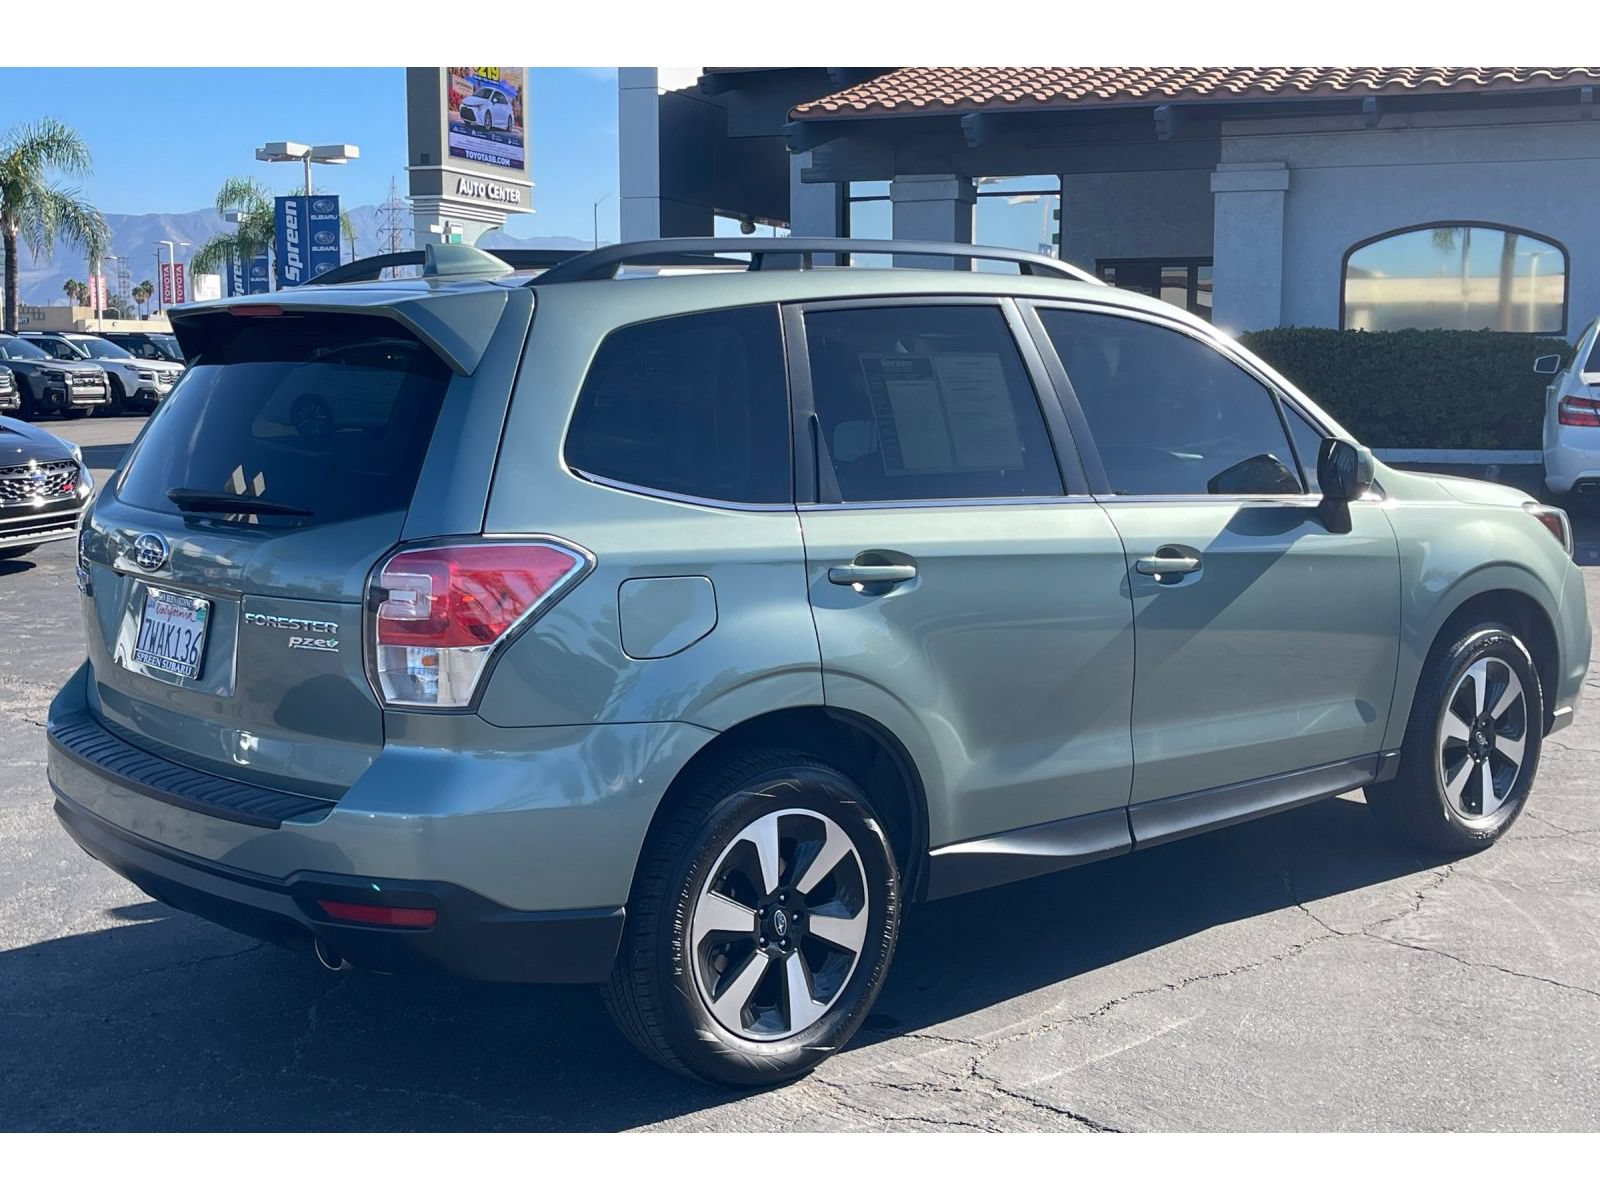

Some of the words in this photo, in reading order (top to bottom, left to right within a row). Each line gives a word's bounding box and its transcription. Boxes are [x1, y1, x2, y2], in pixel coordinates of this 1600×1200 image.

[459, 178, 486, 197] AUTO
[487, 183, 520, 203] CENTER
[284, 200, 303, 282] Spreen
[163, 266, 171, 302] TOYOTA
[175, 265, 183, 302] TOYOTA
[245, 612, 339, 634] FORESTER
[142, 619, 202, 665] 7WAK136
[136, 651, 161, 668] SPREEN
[161, 660, 193, 676] SUBARU
